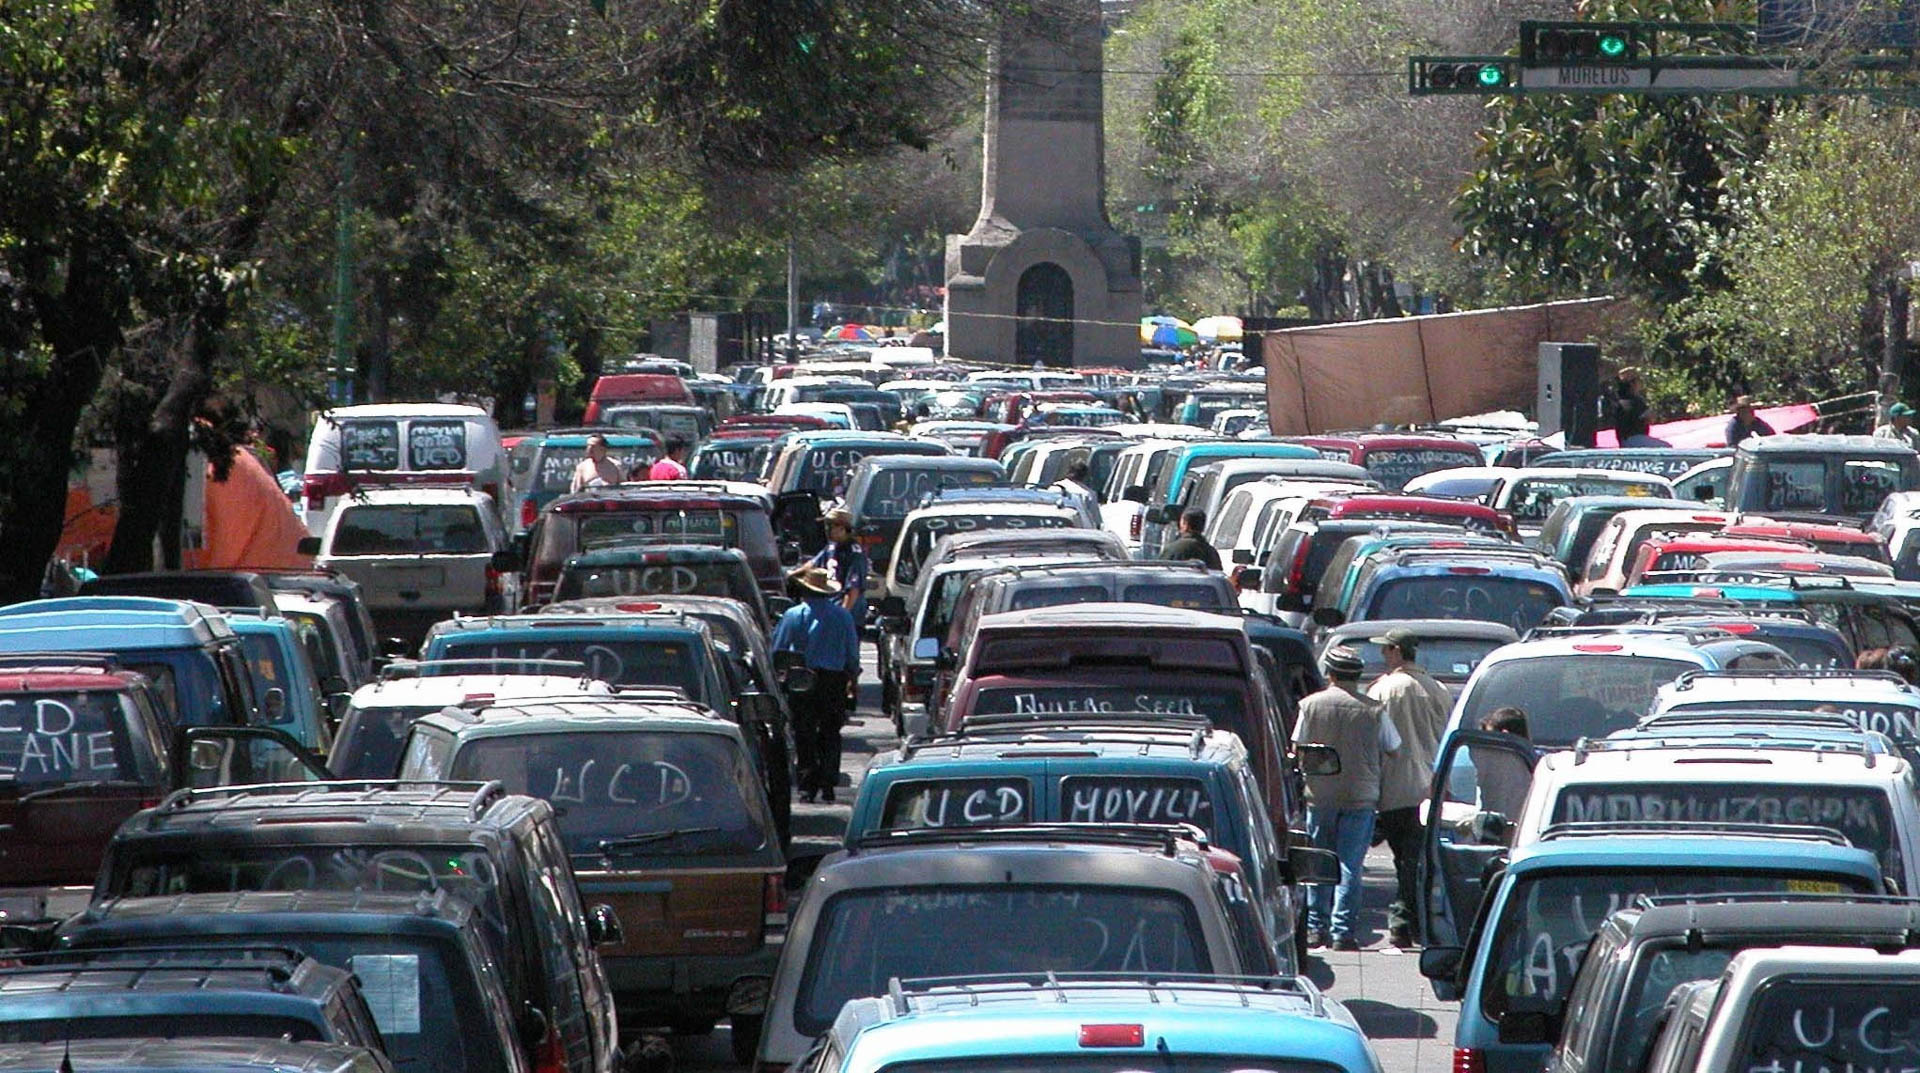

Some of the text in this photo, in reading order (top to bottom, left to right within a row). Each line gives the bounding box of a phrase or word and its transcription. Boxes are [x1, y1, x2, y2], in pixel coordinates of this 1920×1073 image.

[1558, 66, 1630, 84] MORELOS
[612, 566, 698, 595] UCD
[922, 787, 1023, 826] UCD
